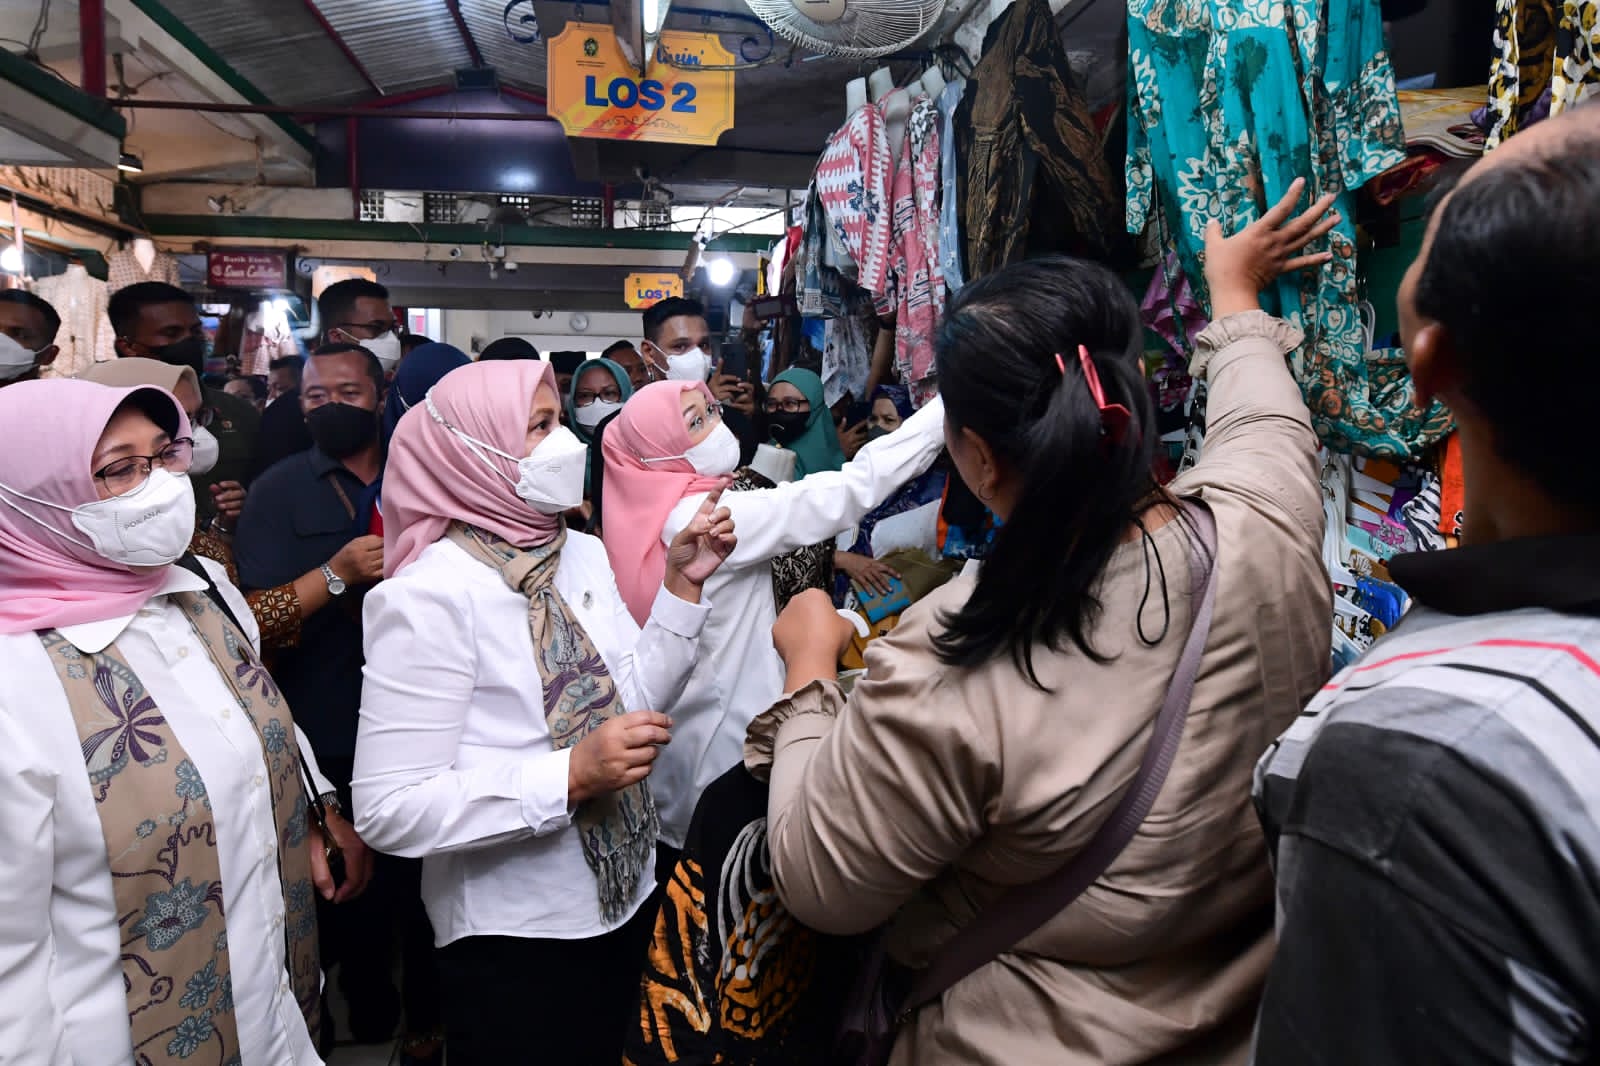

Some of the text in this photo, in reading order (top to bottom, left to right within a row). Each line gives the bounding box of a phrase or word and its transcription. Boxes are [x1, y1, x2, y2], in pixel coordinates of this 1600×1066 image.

[584, 75, 697, 114] LOS 2
[637, 288, 663, 300] LOS
